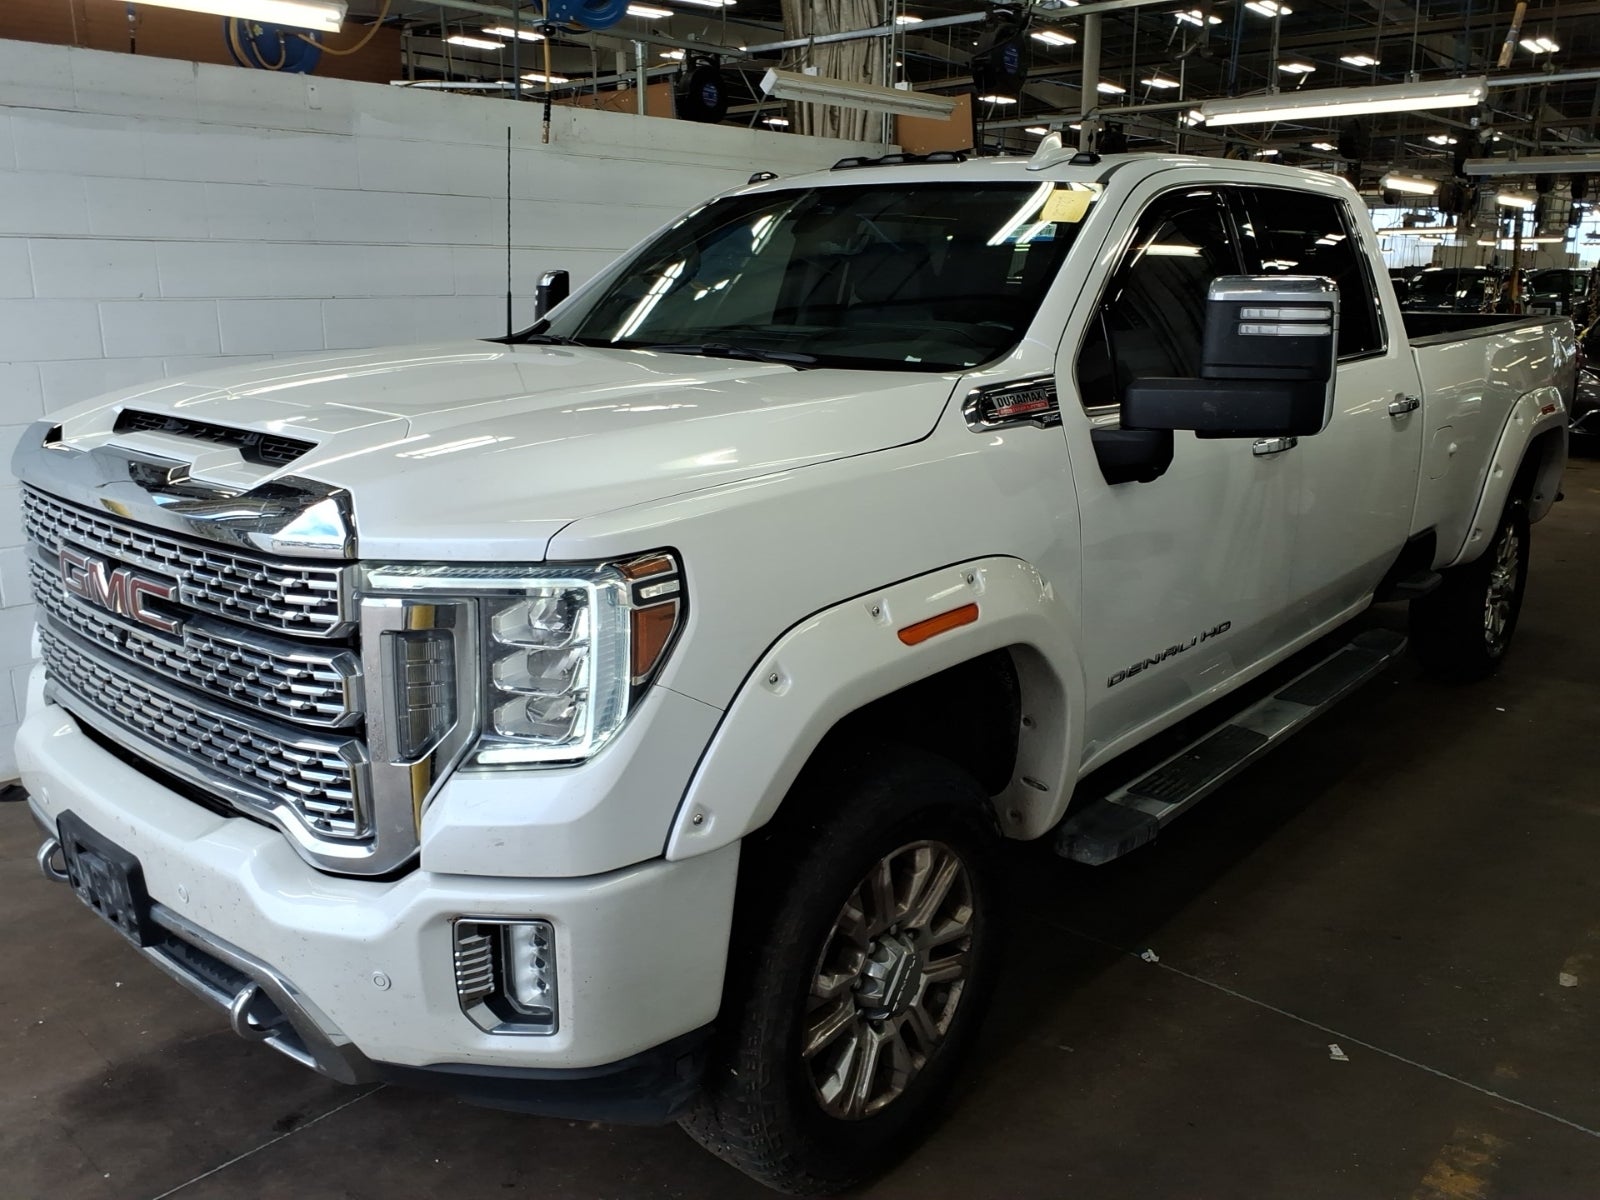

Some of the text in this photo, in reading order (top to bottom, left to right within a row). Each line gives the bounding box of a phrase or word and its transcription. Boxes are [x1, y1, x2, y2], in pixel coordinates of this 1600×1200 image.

[997, 390, 1044, 407] DURAMAX
[60, 546, 183, 637] GMC
[1107, 620, 1231, 688] DENALI HD
